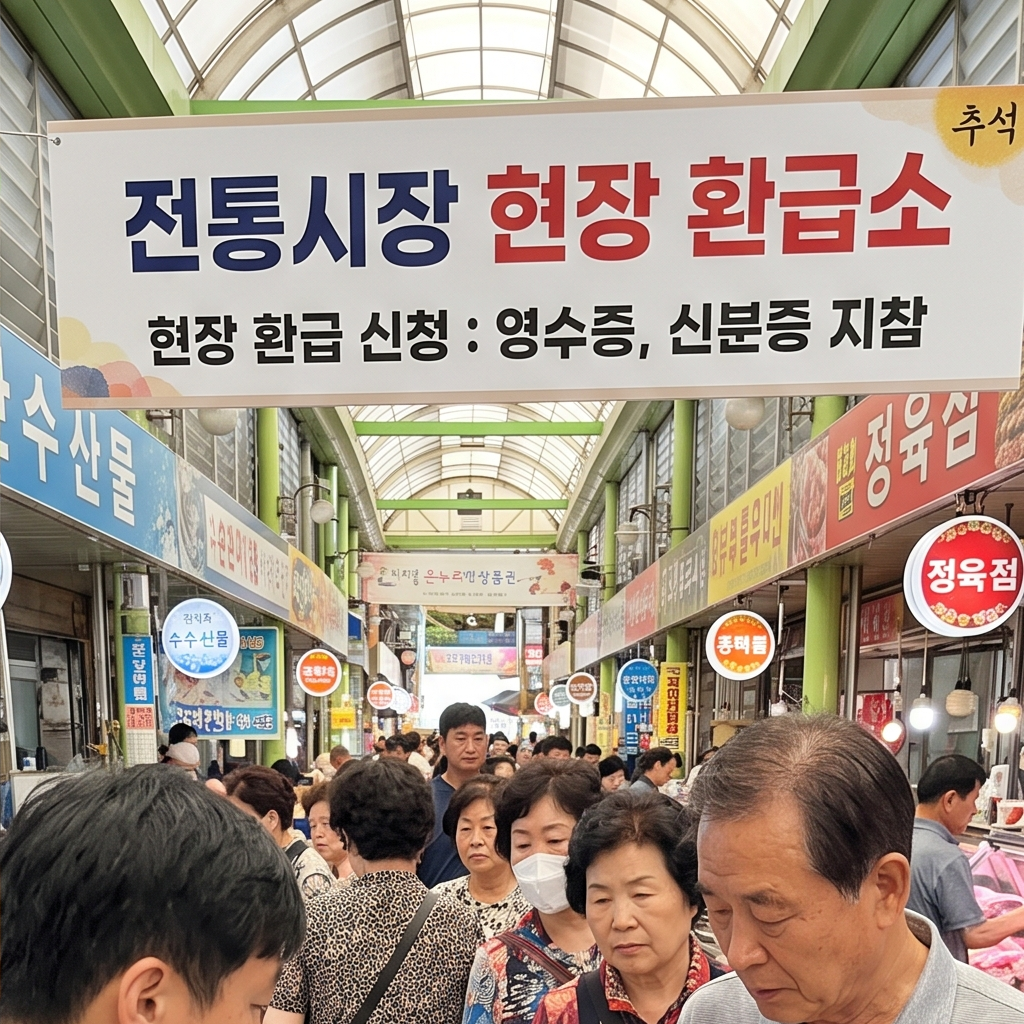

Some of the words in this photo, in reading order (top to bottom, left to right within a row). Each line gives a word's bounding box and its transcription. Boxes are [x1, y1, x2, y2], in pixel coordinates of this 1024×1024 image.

[951, 101, 1019, 148] 추석
[124, 169, 459, 274] 전통시장
[486, 160, 660, 264] 현장
[687, 149, 954, 258] 환급소
[147, 314, 238, 367] 현장
[253, 312, 342, 365] 환급
[359, 308, 451, 363] 신청
[467, 317, 479, 353] :
[495, 304, 651, 361] 영수증,
[669, 298, 812, 357] 신분증
[829, 294, 929, 351] 지참
[927, 557, 1019, 595] 정육점
